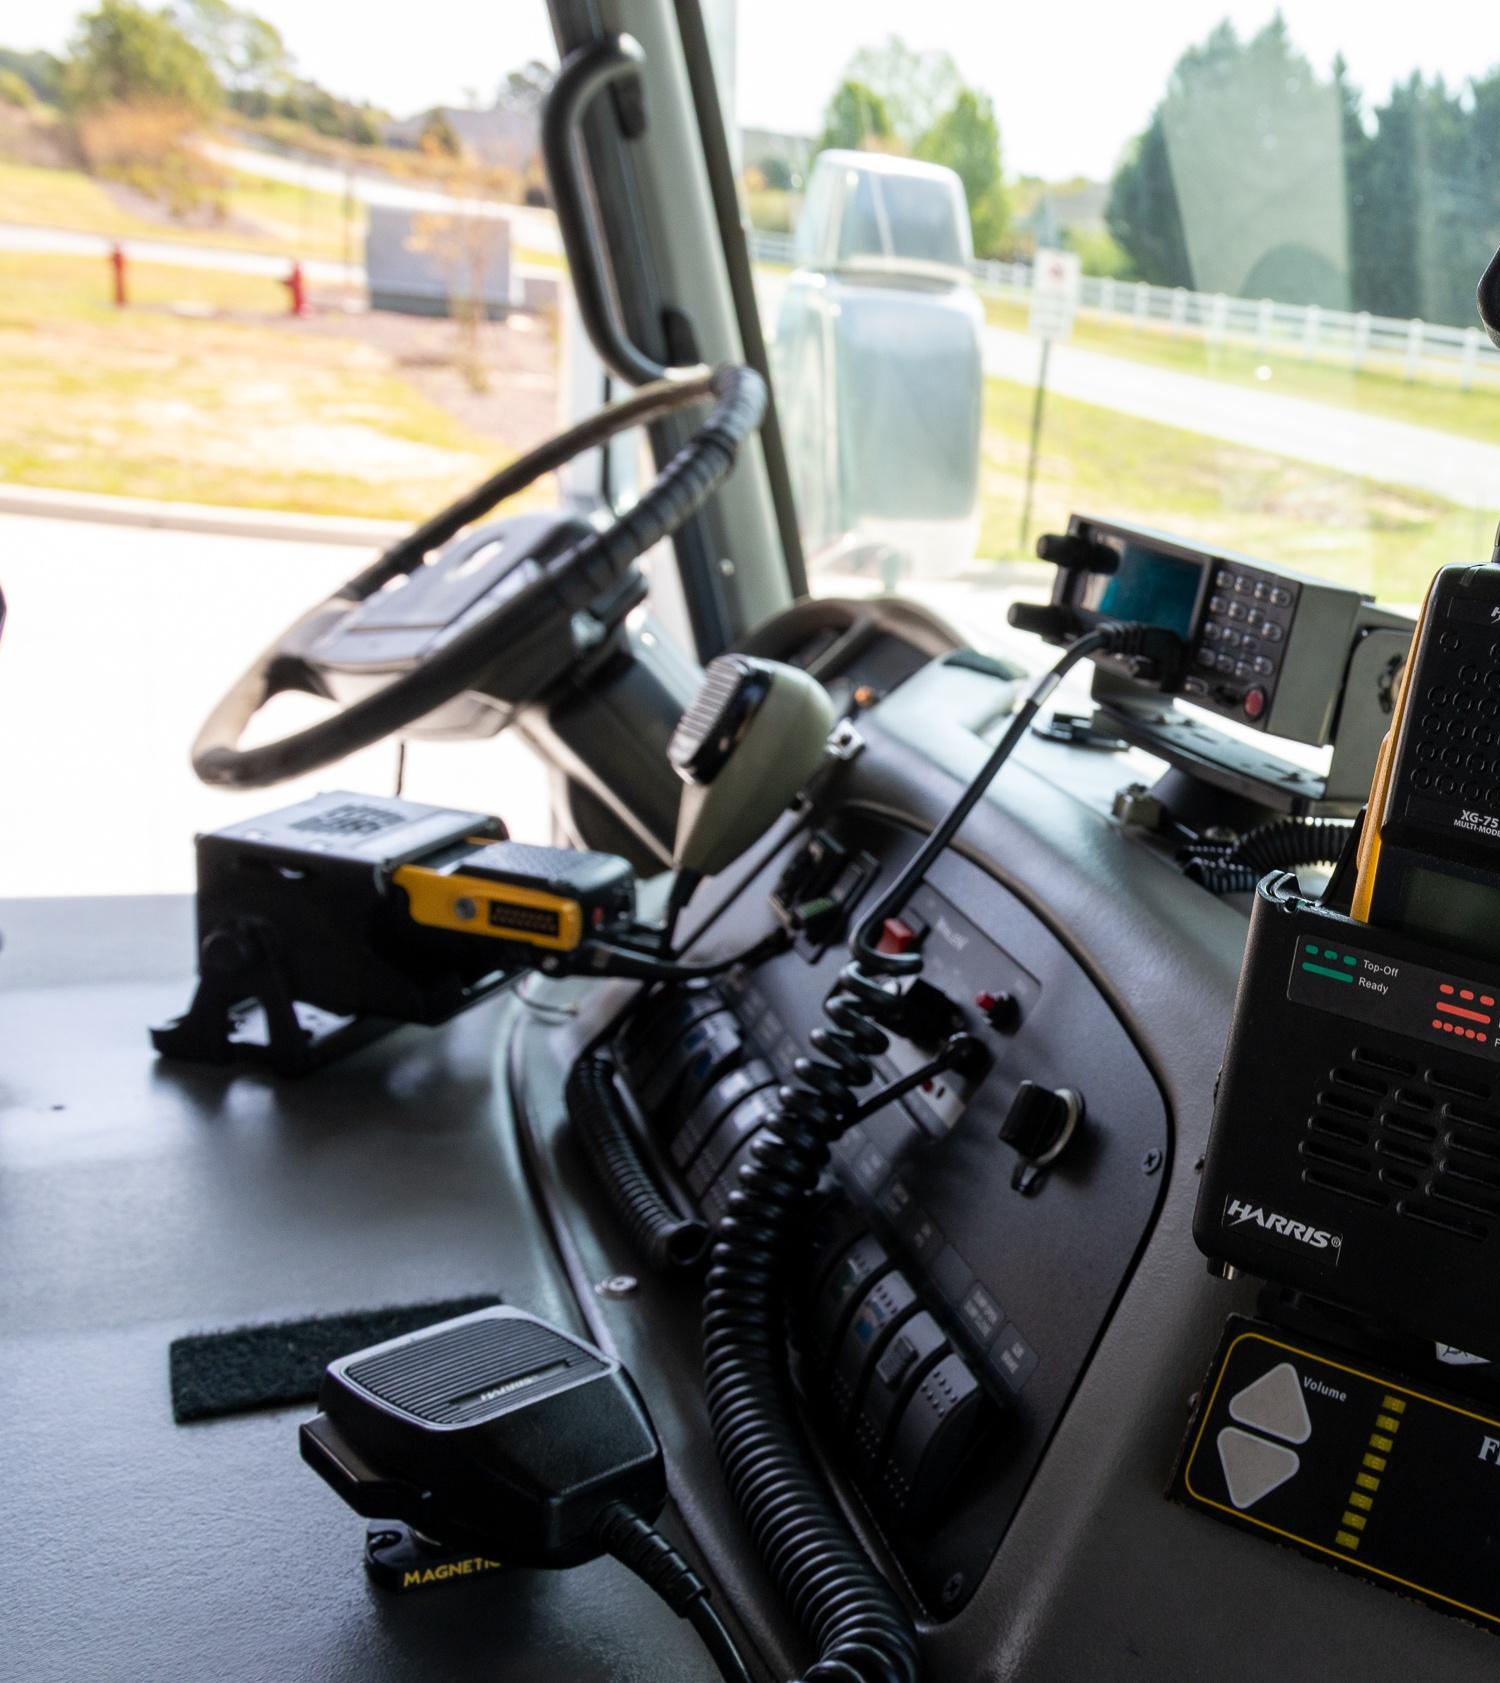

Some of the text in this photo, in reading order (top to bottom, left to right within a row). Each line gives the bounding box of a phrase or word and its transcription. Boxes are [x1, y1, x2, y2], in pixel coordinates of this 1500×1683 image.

[1460, 809, 1500, 829] XG-75
[1362, 959, 1400, 977] Top-Off
[1358, 976, 1389, 996] Ready
[1303, 1375, 1347, 1402] Volume
